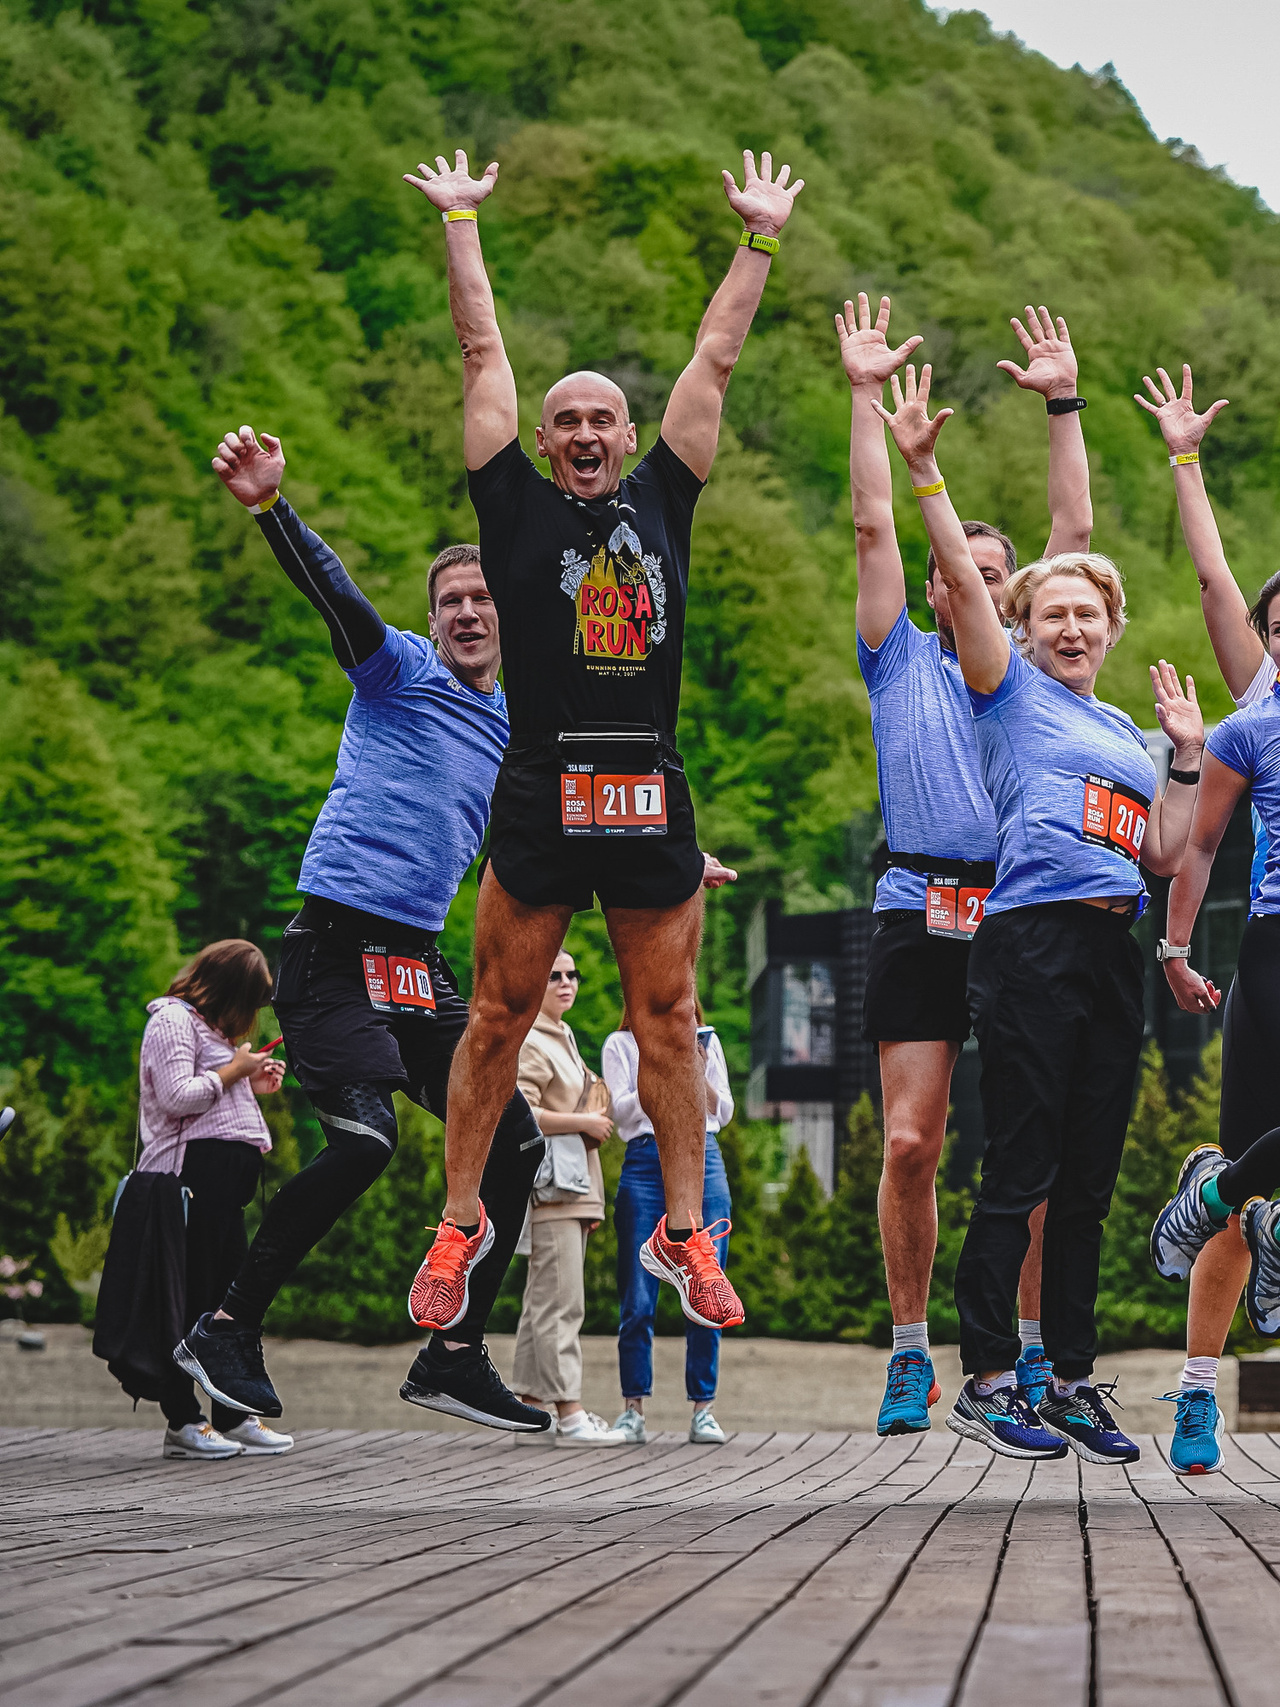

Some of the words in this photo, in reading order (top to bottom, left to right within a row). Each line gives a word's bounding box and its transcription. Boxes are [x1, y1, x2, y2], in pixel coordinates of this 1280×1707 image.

[581, 584, 653, 619] ROSA
[586, 620, 646, 655] RUN
[602, 783, 627, 816] 21
[642, 789, 652, 811] 7
[1115, 804, 1134, 840] 21
[930, 908, 950, 916] ROSA
[395, 964, 415, 996] 21
